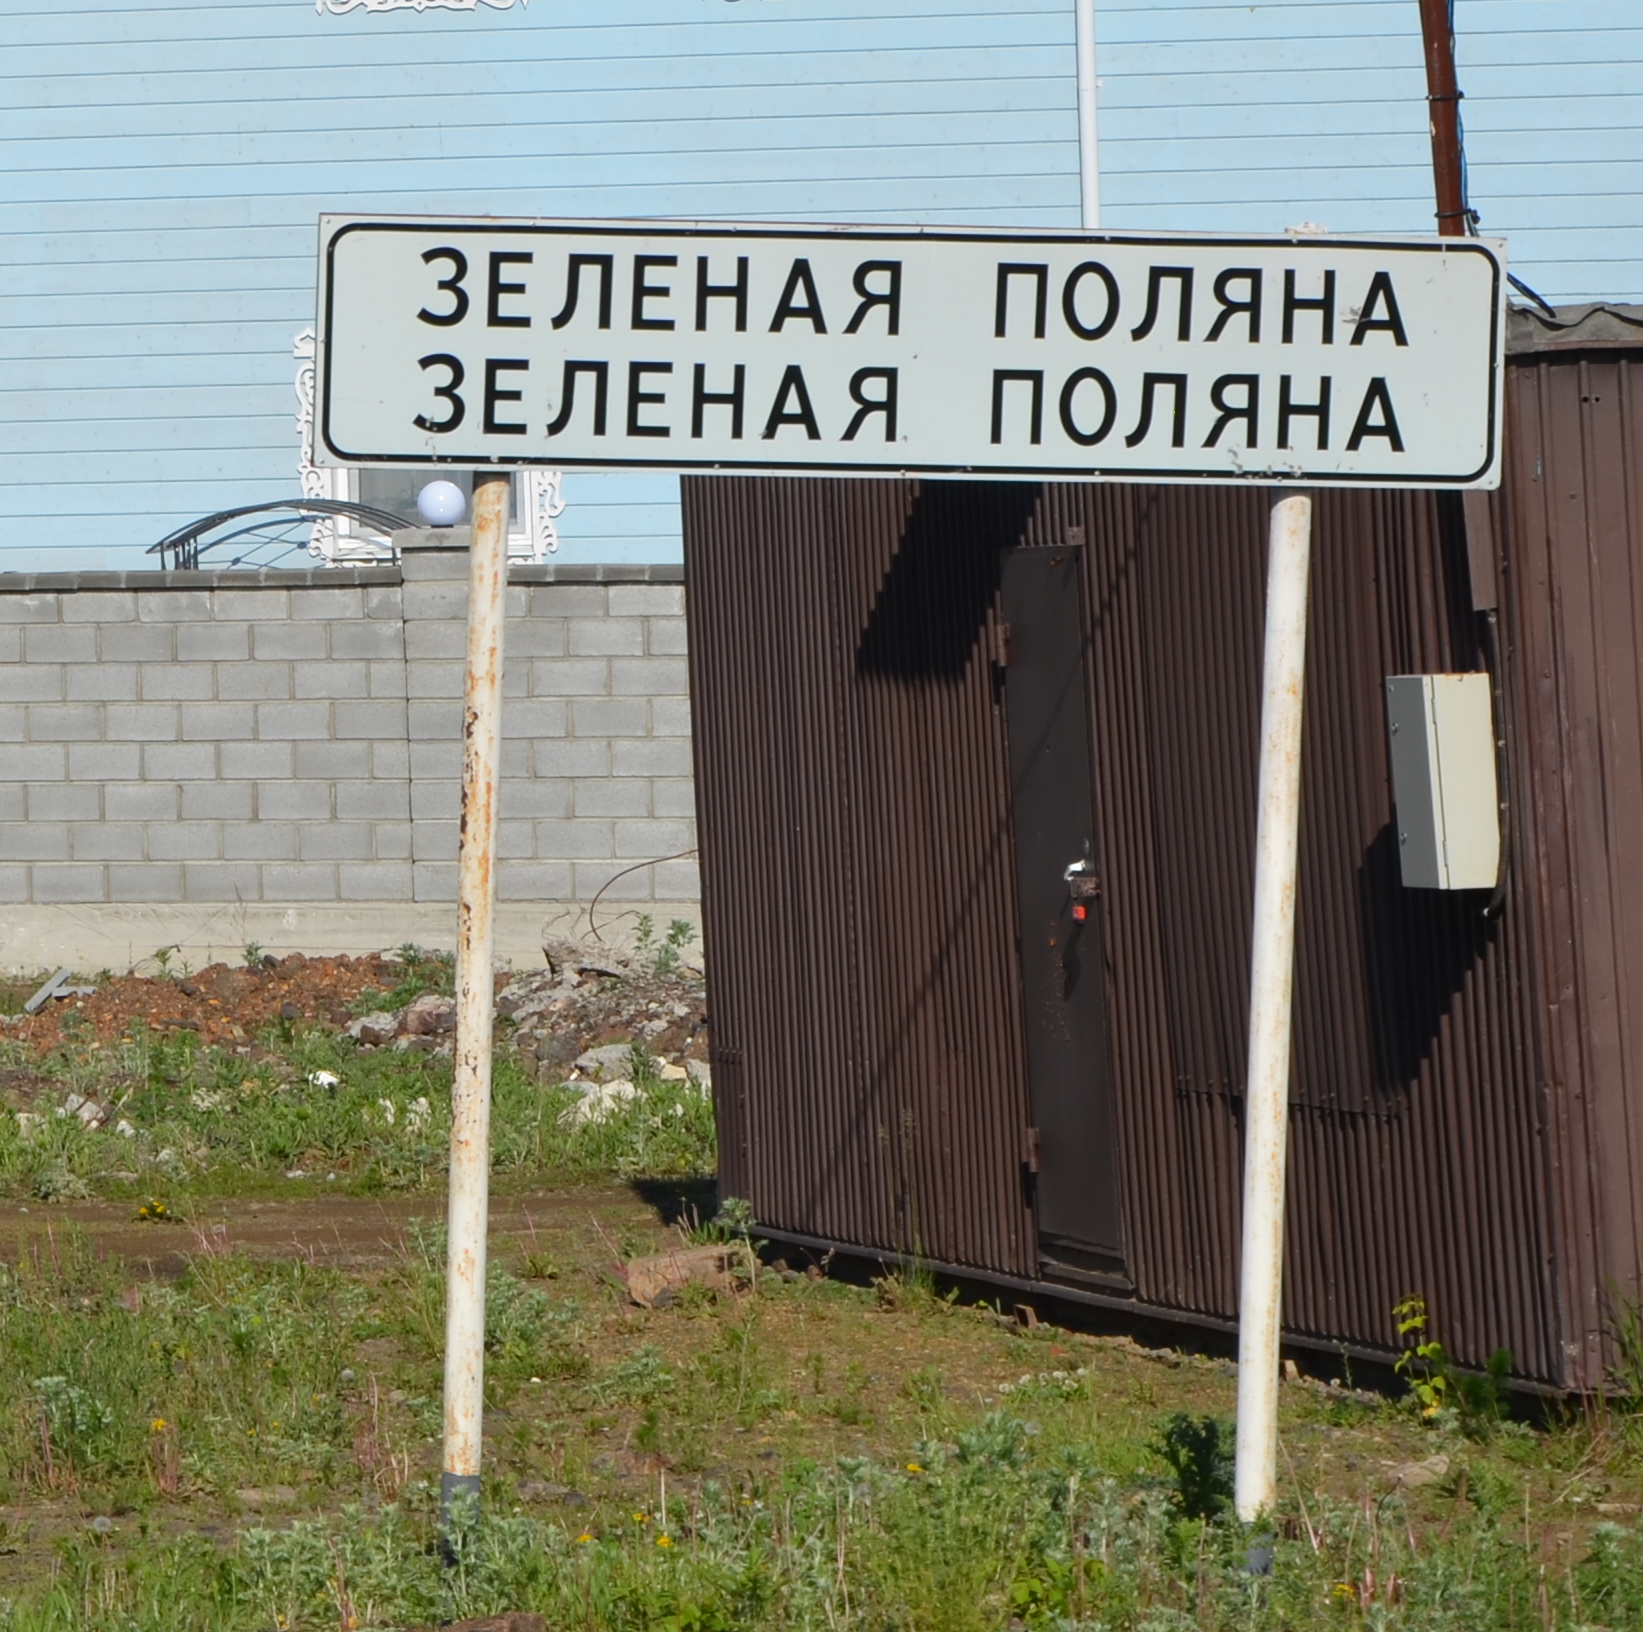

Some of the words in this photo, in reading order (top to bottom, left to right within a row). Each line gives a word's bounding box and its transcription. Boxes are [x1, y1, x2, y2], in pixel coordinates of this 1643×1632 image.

[417, 247, 902, 336] ЗЕЛЕНАЯ
[994, 261, 1408, 347] ПОЛЯНА
[413, 353, 898, 442] ЗЕЛЕНАЯ
[990, 366, 1405, 453] ПОЛЯНА
